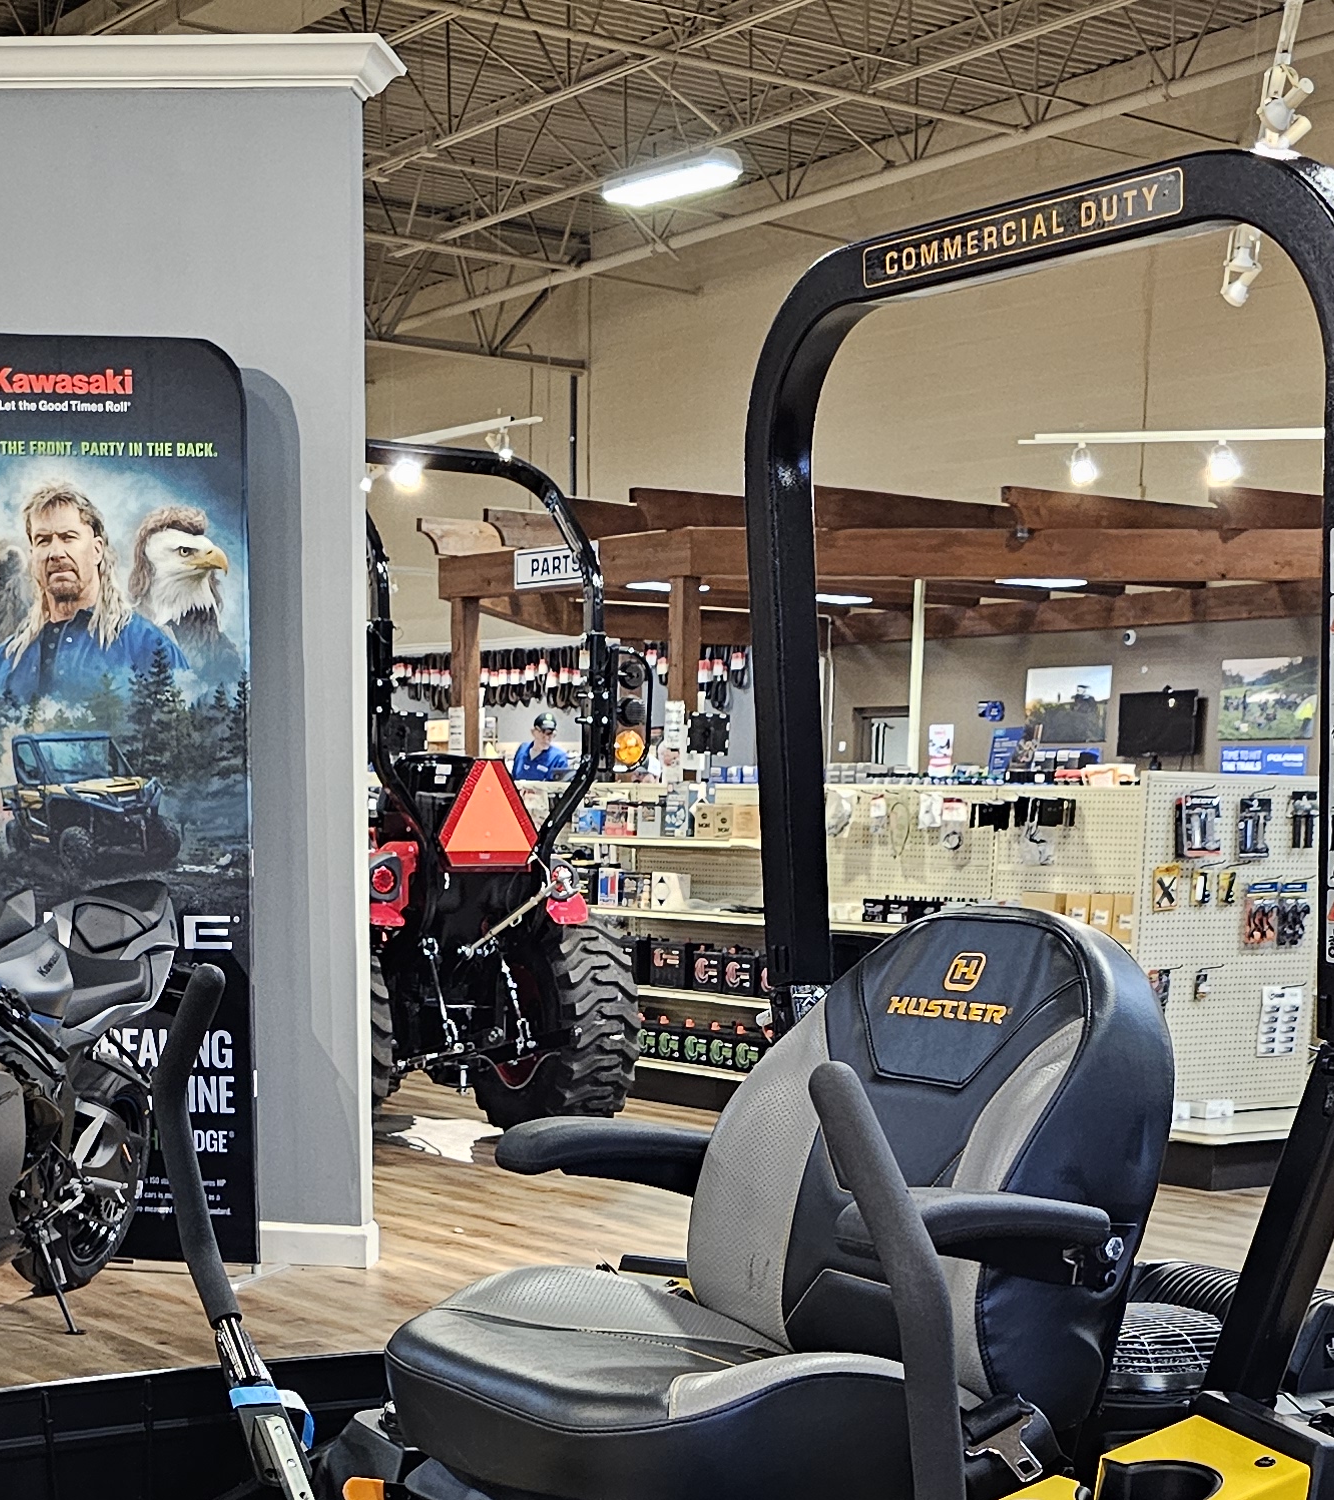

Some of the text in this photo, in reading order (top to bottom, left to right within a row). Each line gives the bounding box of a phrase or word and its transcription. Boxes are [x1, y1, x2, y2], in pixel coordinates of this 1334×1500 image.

[884, 183, 1159, 275] COMMERCIAL DUTY
[18, 400, 37, 412] the
[38, 400, 68, 412] Good
[70, 400, 104, 413] Times
[0, 440, 26, 456] THE
[29, 441, 78, 457] FRONT.
[80, 441, 125, 457] PARTY
[128, 442, 143, 457] IN
[146, 442, 173, 457] THE
[176, 442, 218, 458] BACK.
[530, 554, 581, 578] PARTS
[887, 996, 1008, 1025] HUSTLER
